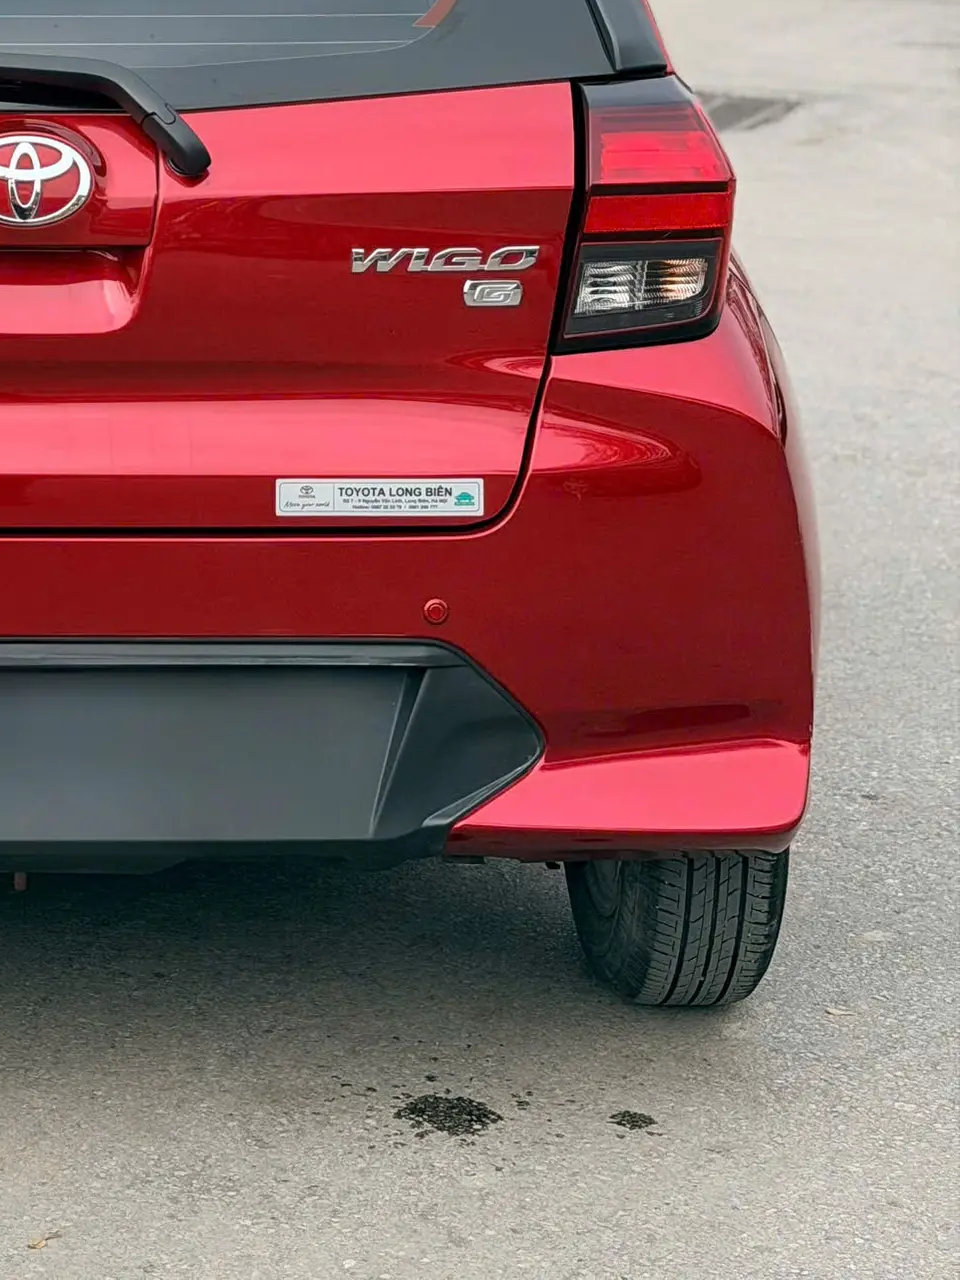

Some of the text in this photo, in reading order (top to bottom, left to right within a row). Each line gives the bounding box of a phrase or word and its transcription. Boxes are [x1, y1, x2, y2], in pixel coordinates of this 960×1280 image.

[352, 246, 540, 272] WIGO
[338, 485, 452, 497] TOYOTA LONG BIÊN
